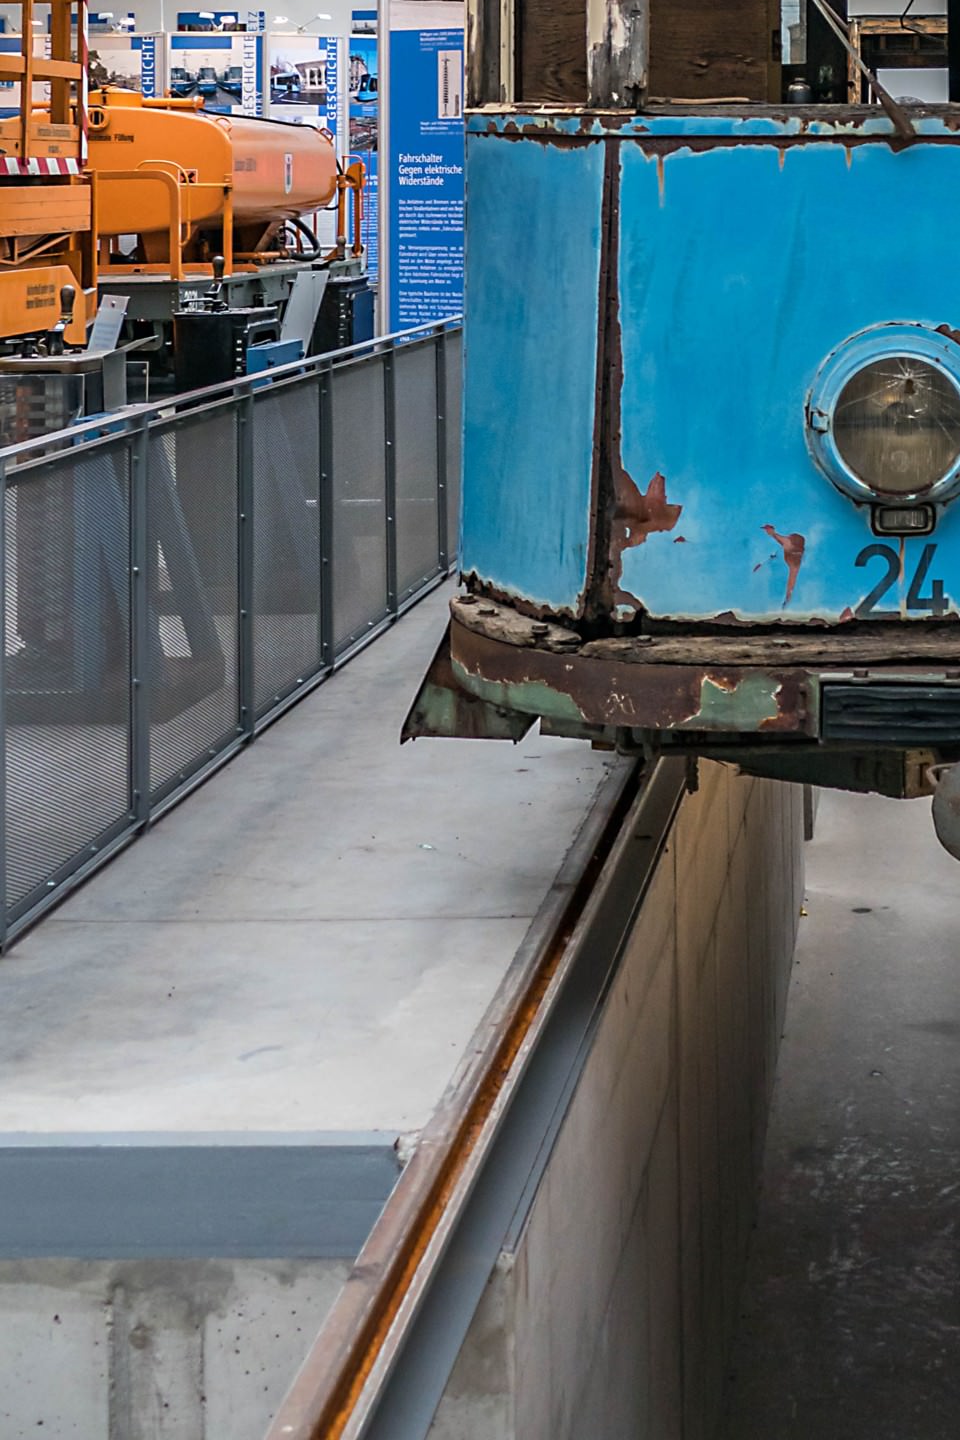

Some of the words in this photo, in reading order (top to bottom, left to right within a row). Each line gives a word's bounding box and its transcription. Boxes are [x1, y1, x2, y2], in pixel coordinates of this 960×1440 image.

[327, 36, 337, 120] GESCHICHTE
[399, 153, 443, 163] Fahrschalter
[399, 165, 423, 177] Gegen
[425, 165, 463, 174] elektrische
[399, 176, 444, 185] Widerstände
[854, 543, 949, 619] 24
